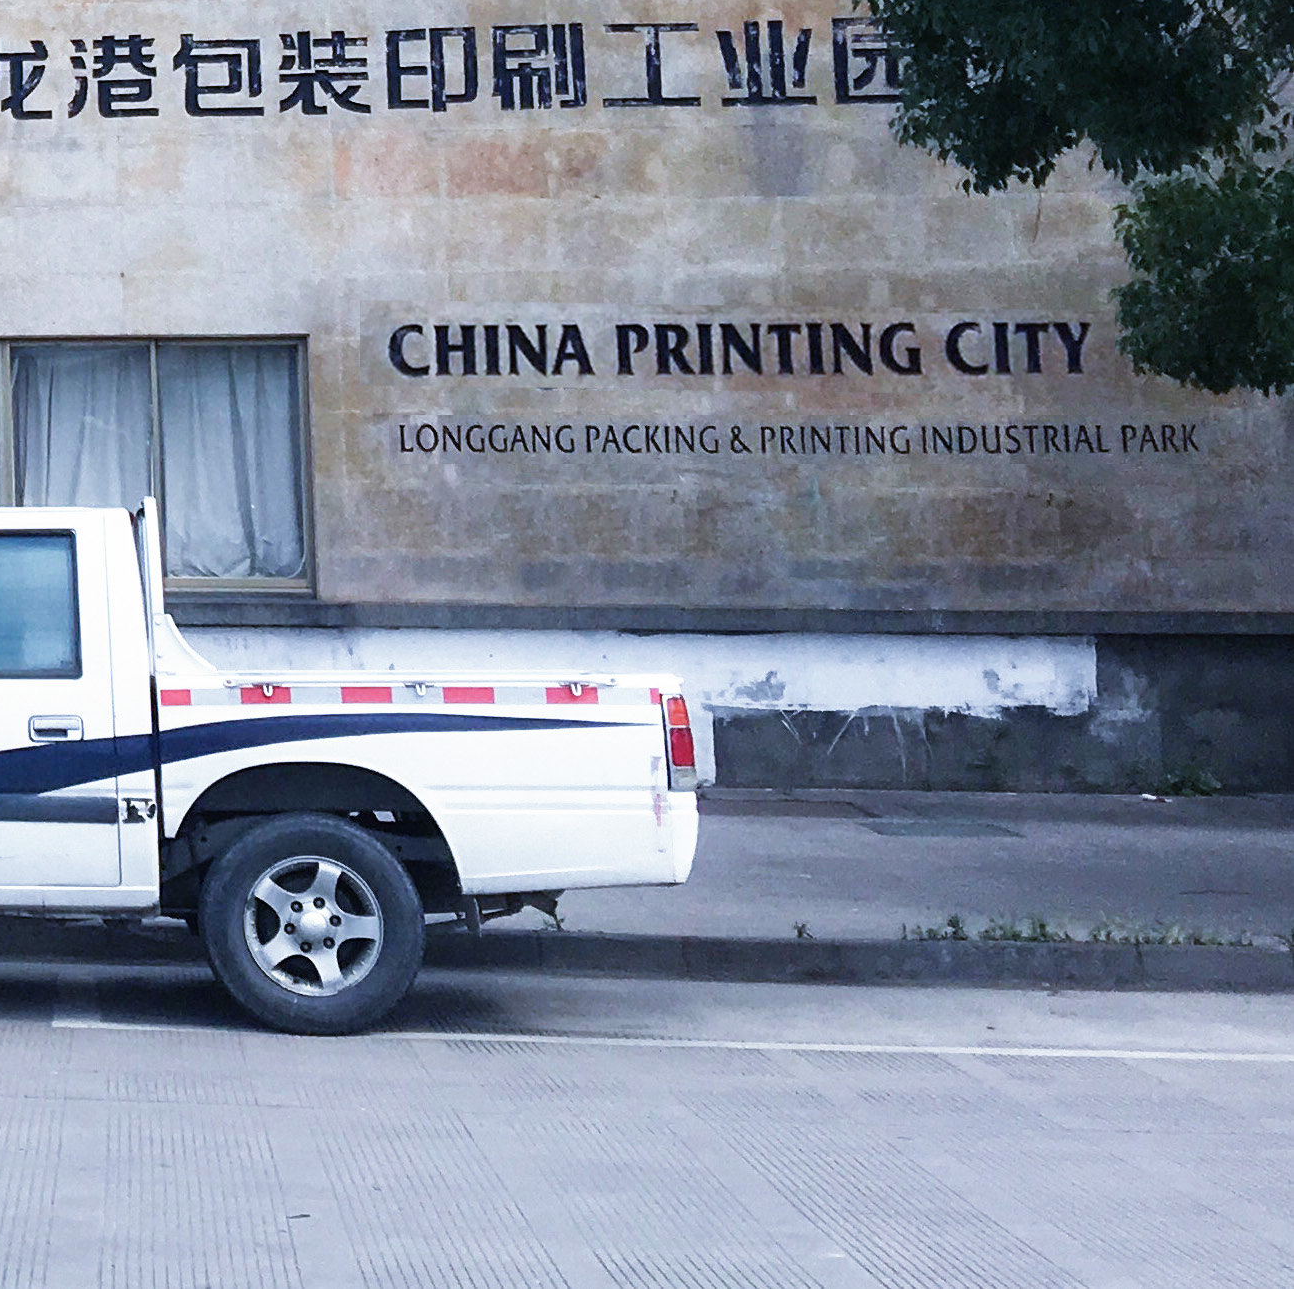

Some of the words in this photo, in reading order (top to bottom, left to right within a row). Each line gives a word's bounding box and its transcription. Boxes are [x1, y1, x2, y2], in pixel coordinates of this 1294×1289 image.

[389, 323, 595, 378] CHINA
[616, 322, 921, 376] PRINTING
[945, 321, 1091, 376] CITY
[399, 423, 575, 455] LONGGANG
[585, 423, 719, 455] PACKING
[730, 424, 753, 455] &
[761, 424, 910, 455] PRINTING
[920, 424, 1111, 455] INDUSTRIAL
[1122, 424, 1201, 454] PARK
